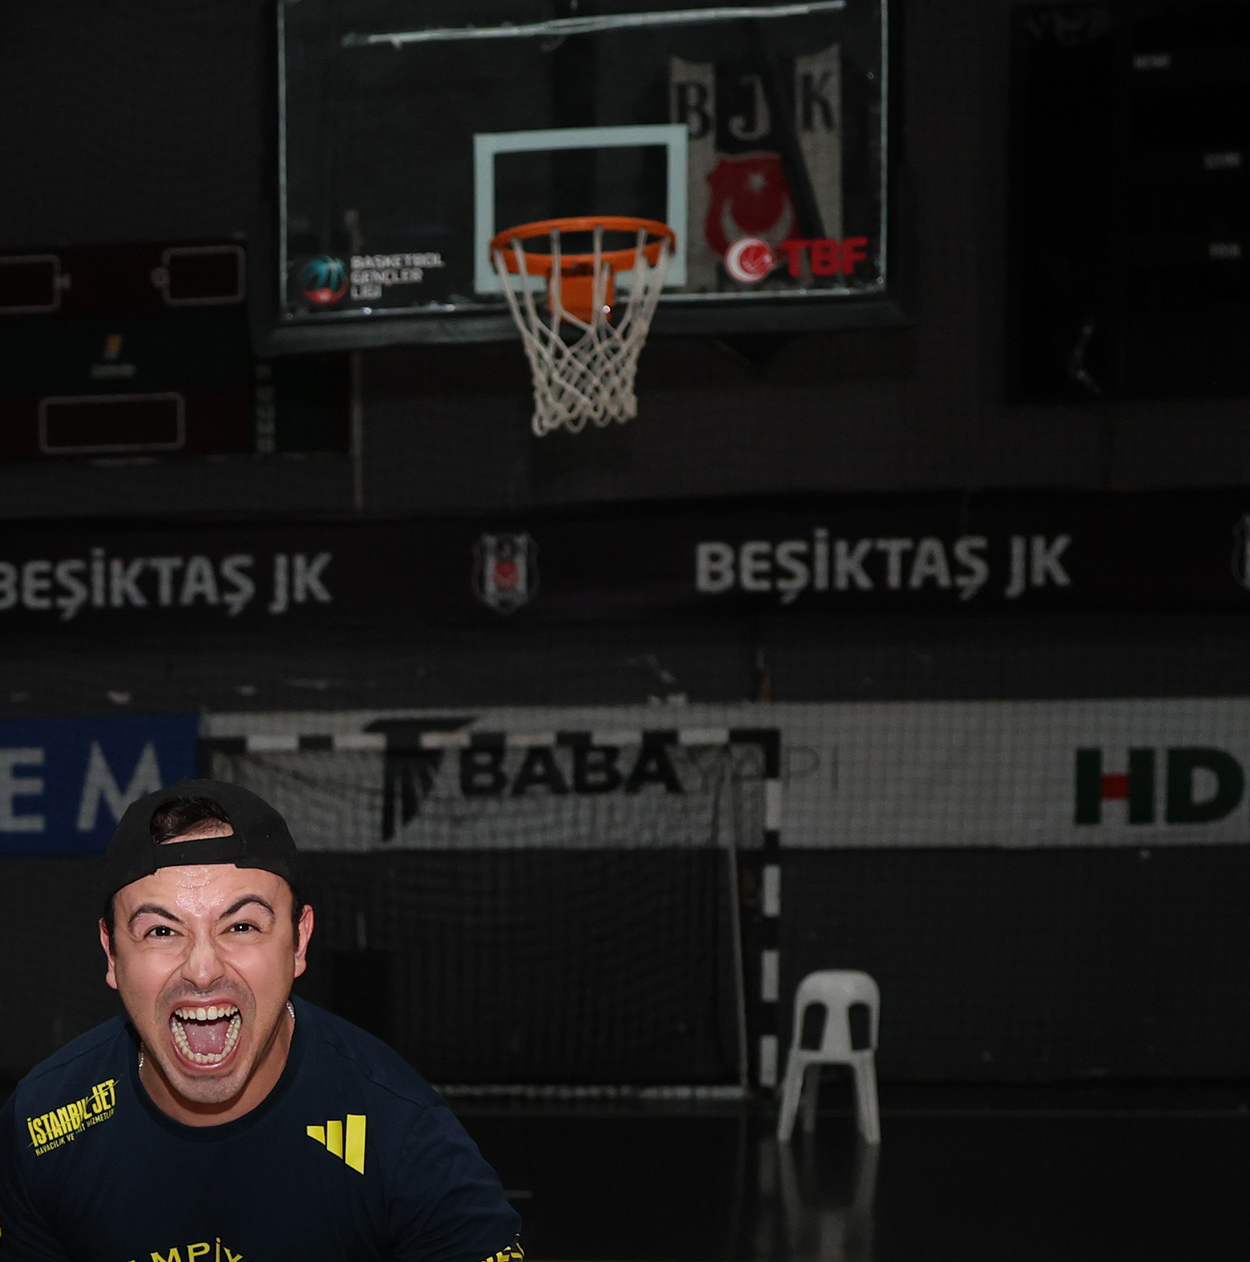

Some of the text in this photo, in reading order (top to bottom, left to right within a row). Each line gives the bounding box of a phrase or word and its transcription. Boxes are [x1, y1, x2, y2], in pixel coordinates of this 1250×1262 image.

[779, 236, 869, 277] TBF
[269, 552, 333, 614] JK
[695, 527, 1073, 604] BEŞİKTAŞ JK
[459, 742, 684, 796] BABA
[1076, 747, 1250, 825] HD
[92, 1079, 116, 1114] JET
